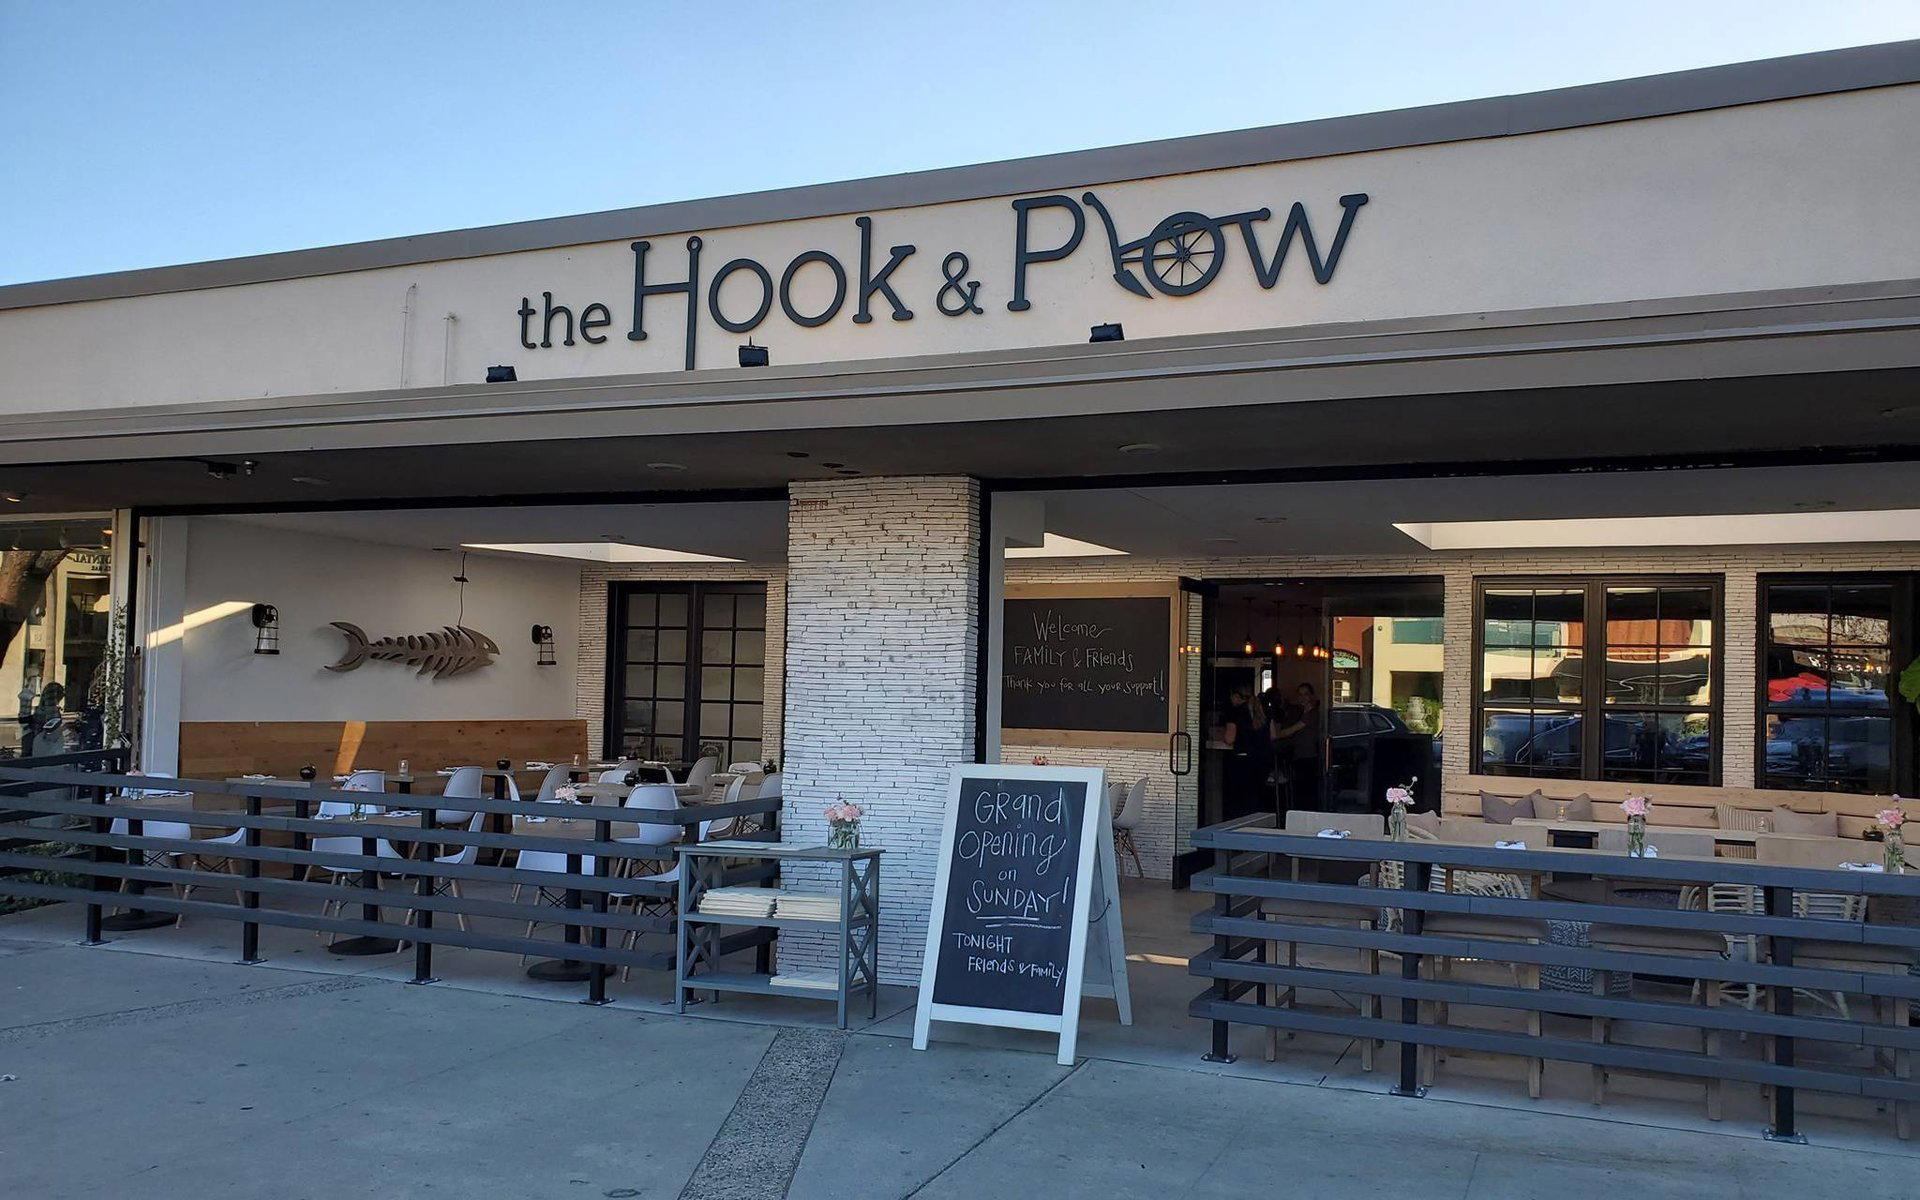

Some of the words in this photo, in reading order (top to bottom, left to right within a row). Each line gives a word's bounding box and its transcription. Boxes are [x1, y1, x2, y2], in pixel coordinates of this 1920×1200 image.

[517, 291, 612, 350] the
[936, 250, 985, 317] &
[998, 868, 1018, 882] on
[952, 932, 1013, 954] TONIGHT
